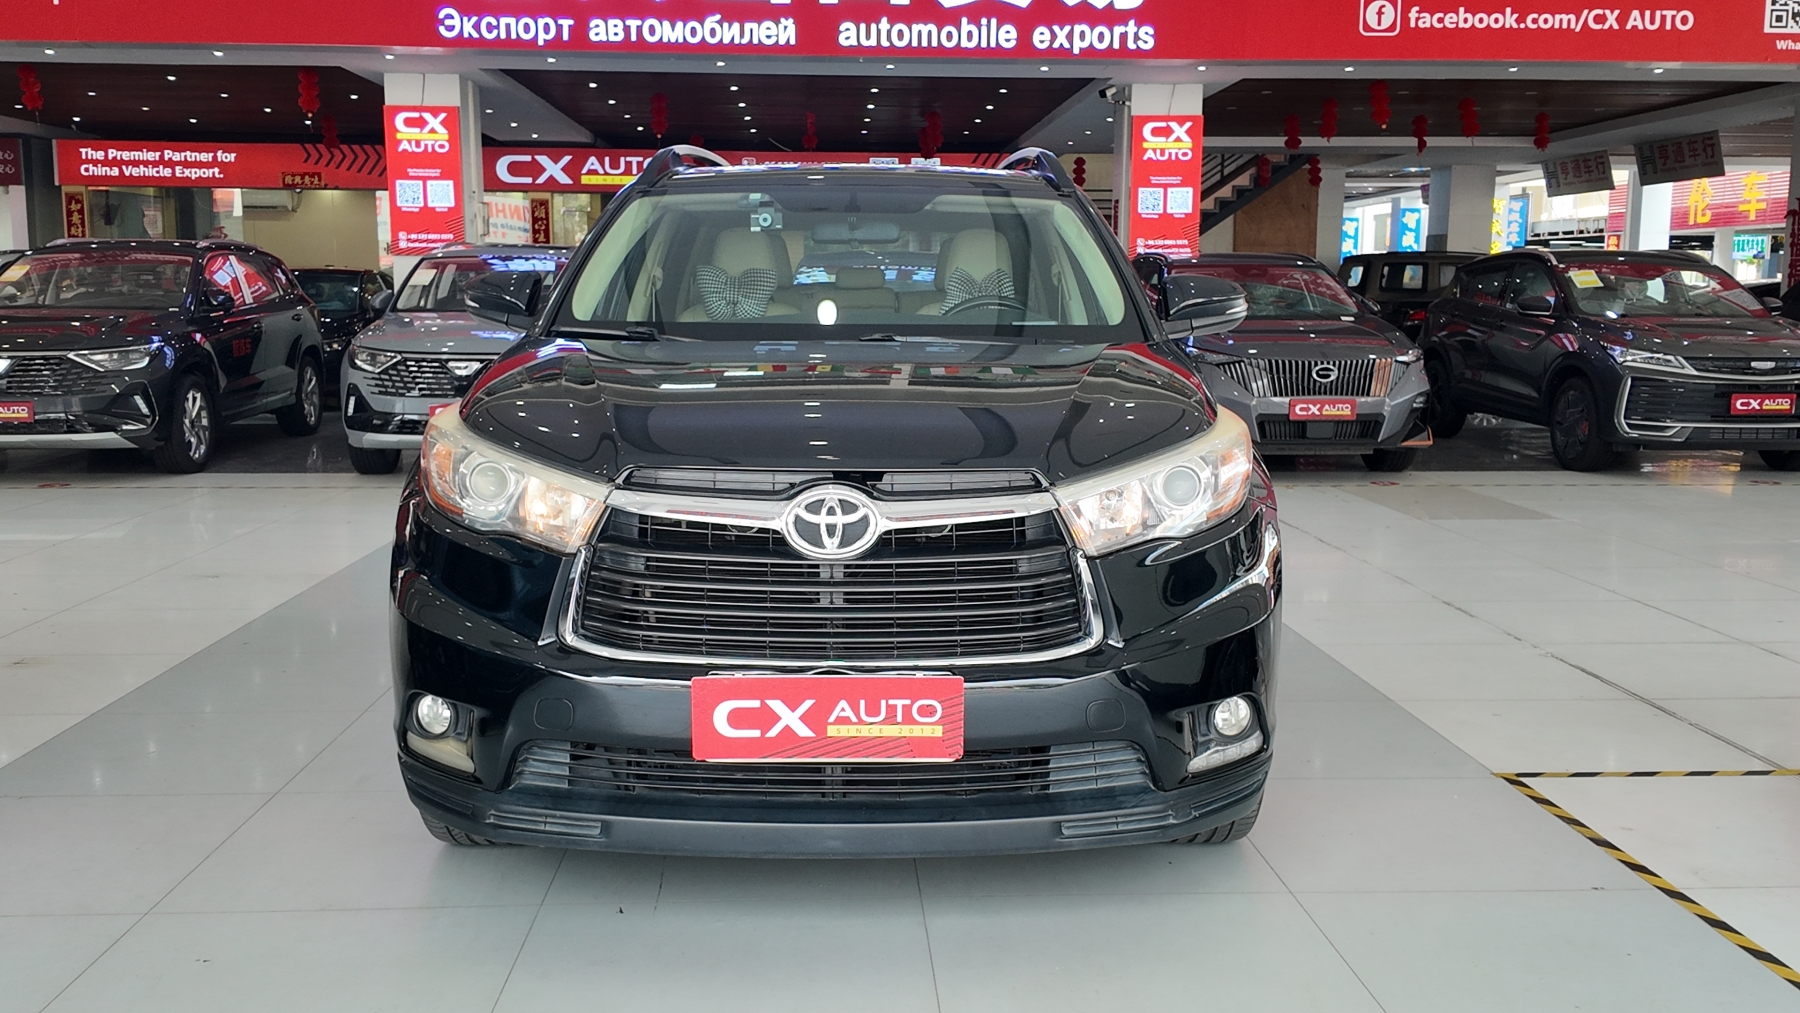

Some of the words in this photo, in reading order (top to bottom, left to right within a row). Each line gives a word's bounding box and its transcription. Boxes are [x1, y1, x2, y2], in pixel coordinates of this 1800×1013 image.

[437, 7, 575, 46] Экспорт
[589, 14, 796, 46] автомобилей
[1409, 6, 1620, 32] facebook.com/CX
[1625, 9, 1695, 31] AUTO
[838, 17, 1018, 49] automobile
[1032, 19, 1155, 54] exports
[395, 111, 449, 134] CX
[1142, 121, 1193, 142] CX
[79, 147, 105, 160] The
[108, 149, 161, 161] Premier
[164, 150, 214, 162] Partner
[216, 150, 237, 162] for
[397, 140, 450, 153] AUTO
[1142, 149, 1193, 161] AUTO
[80, 164, 119, 176] China
[122, 165, 172, 177] Vehicle
[175, 166, 224, 180] Export.
[496, 155, 573, 184] CX
[1295, 403, 1321, 415] CX
[1322, 403, 1352, 412] AUTO
[1735, 398, 1762, 410] CX
[1763, 398, 1792, 406] AUTO
[713, 699, 816, 738] CX
[827, 699, 943, 723] AUTO
[836, 727, 884, 735] SINCE
[898, 727, 936, 735] 2012
